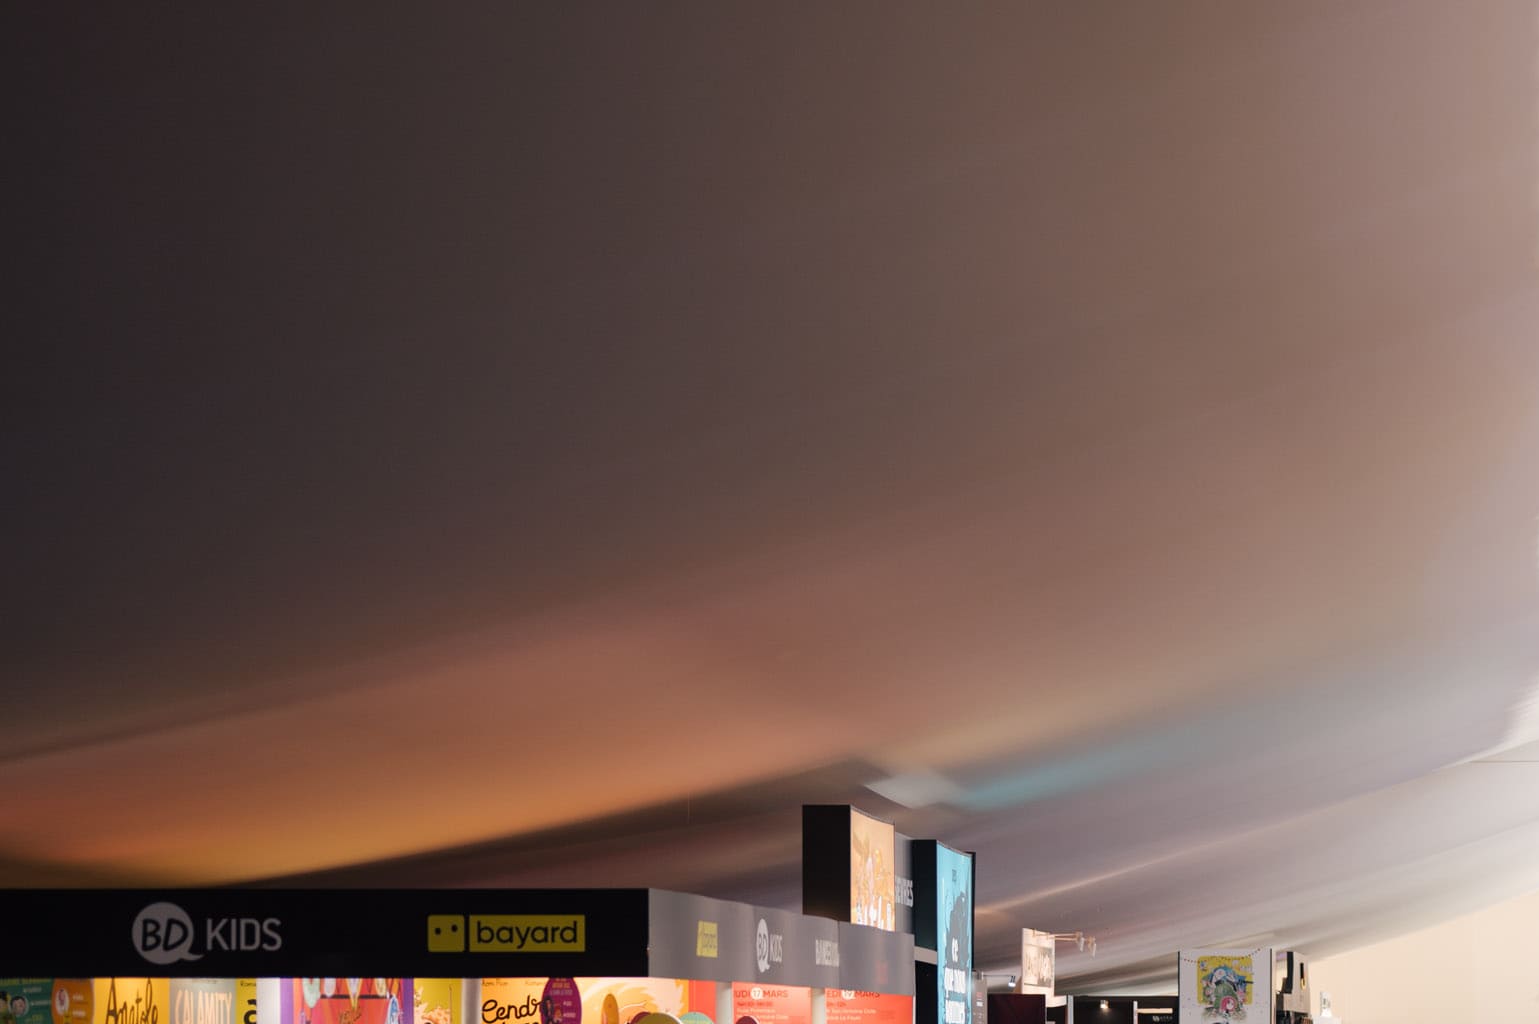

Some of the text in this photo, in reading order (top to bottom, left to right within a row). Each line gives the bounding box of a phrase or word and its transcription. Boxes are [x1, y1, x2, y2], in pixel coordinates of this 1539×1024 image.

[141, 918, 282, 951] BD KIDS
[477, 920, 578, 950] bayard
[763, 990, 789, 999] MARS
